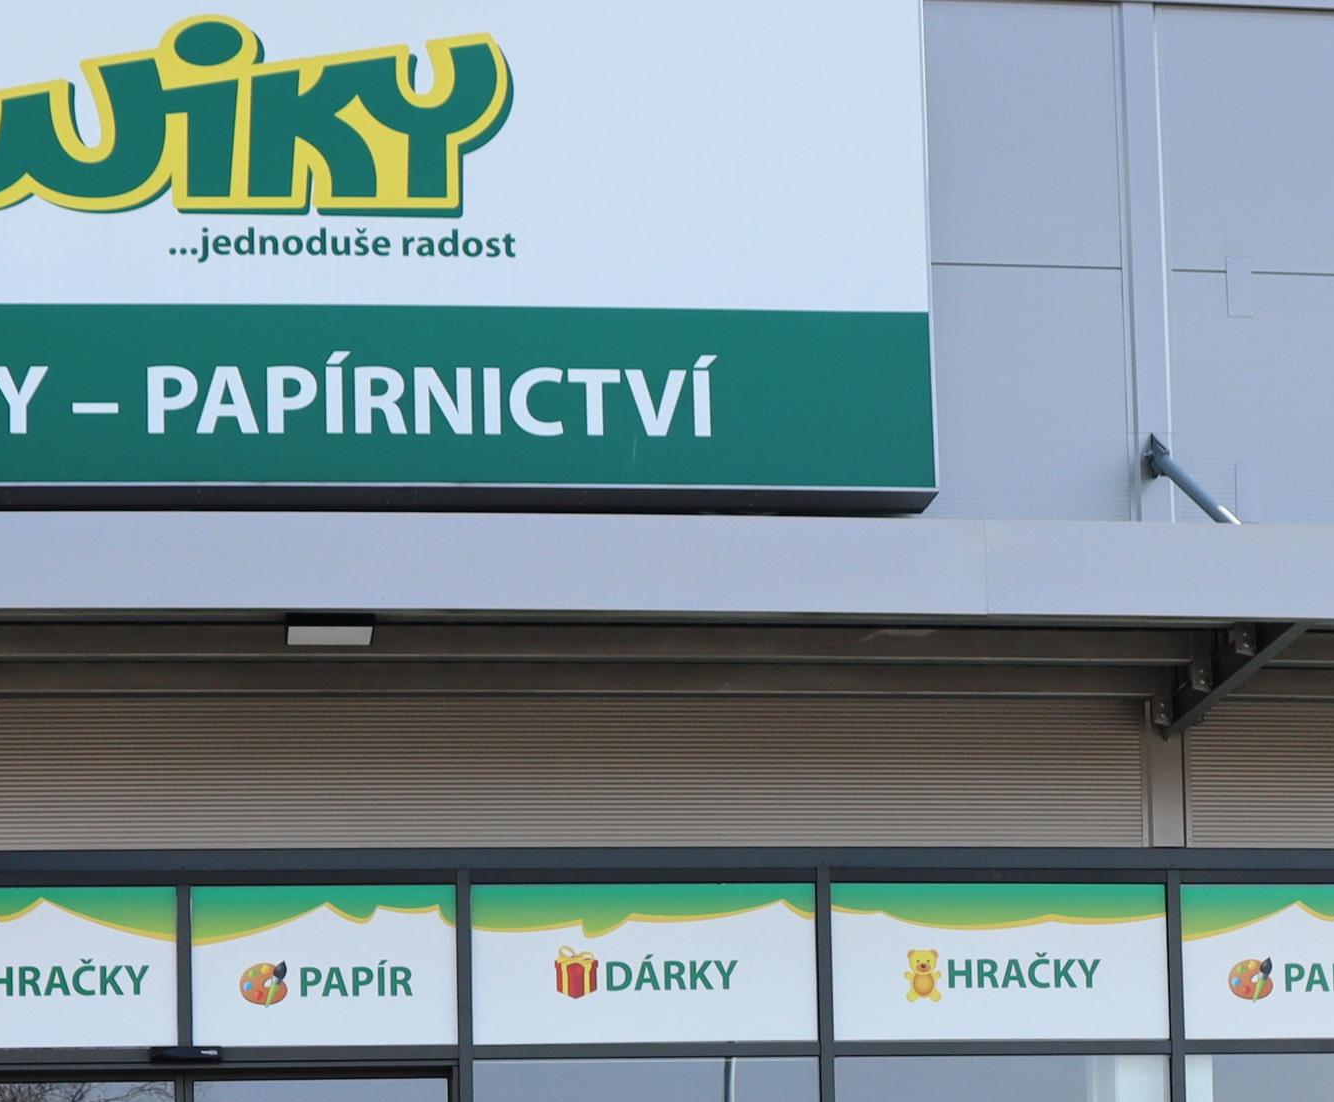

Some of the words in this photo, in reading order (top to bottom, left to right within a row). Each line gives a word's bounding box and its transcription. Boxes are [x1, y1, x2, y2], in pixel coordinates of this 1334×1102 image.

[169, 226, 390, 263] ...jednoduše
[400, 228, 517, 260] radost
[145, 352, 715, 438] PAPÍRNICTVÍ
[299, 957, 413, 998] PAPÍR
[605, 952, 739, 992] DÁRKY
[947, 951, 1101, 990] HRAČKY
